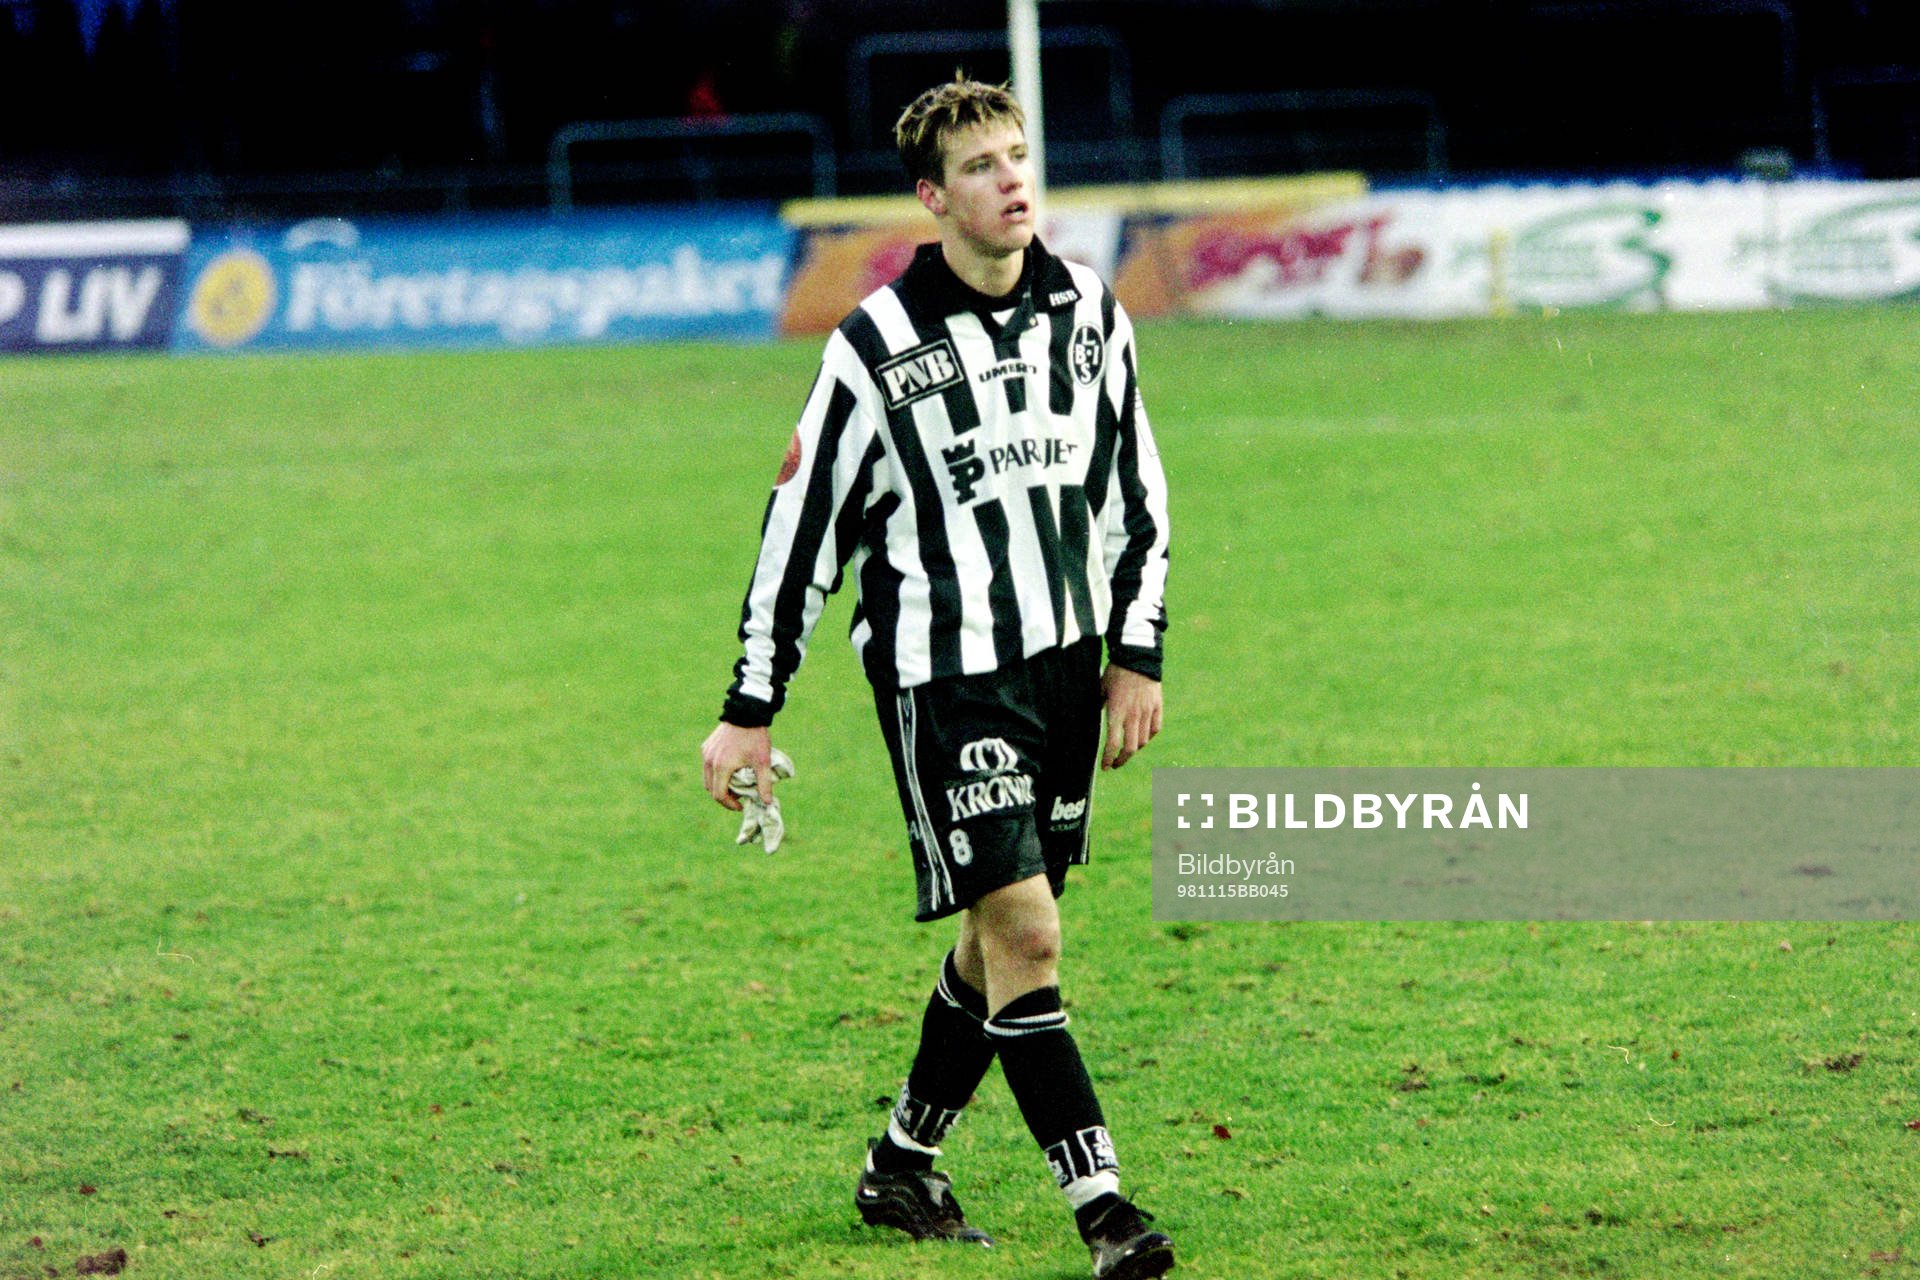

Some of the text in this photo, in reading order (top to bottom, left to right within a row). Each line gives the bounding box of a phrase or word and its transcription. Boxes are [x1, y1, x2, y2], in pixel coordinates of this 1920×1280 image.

[36, 264, 163, 343] LIV
[1049, 290, 1078, 307] HSB
[950, 829, 974, 867] 8
